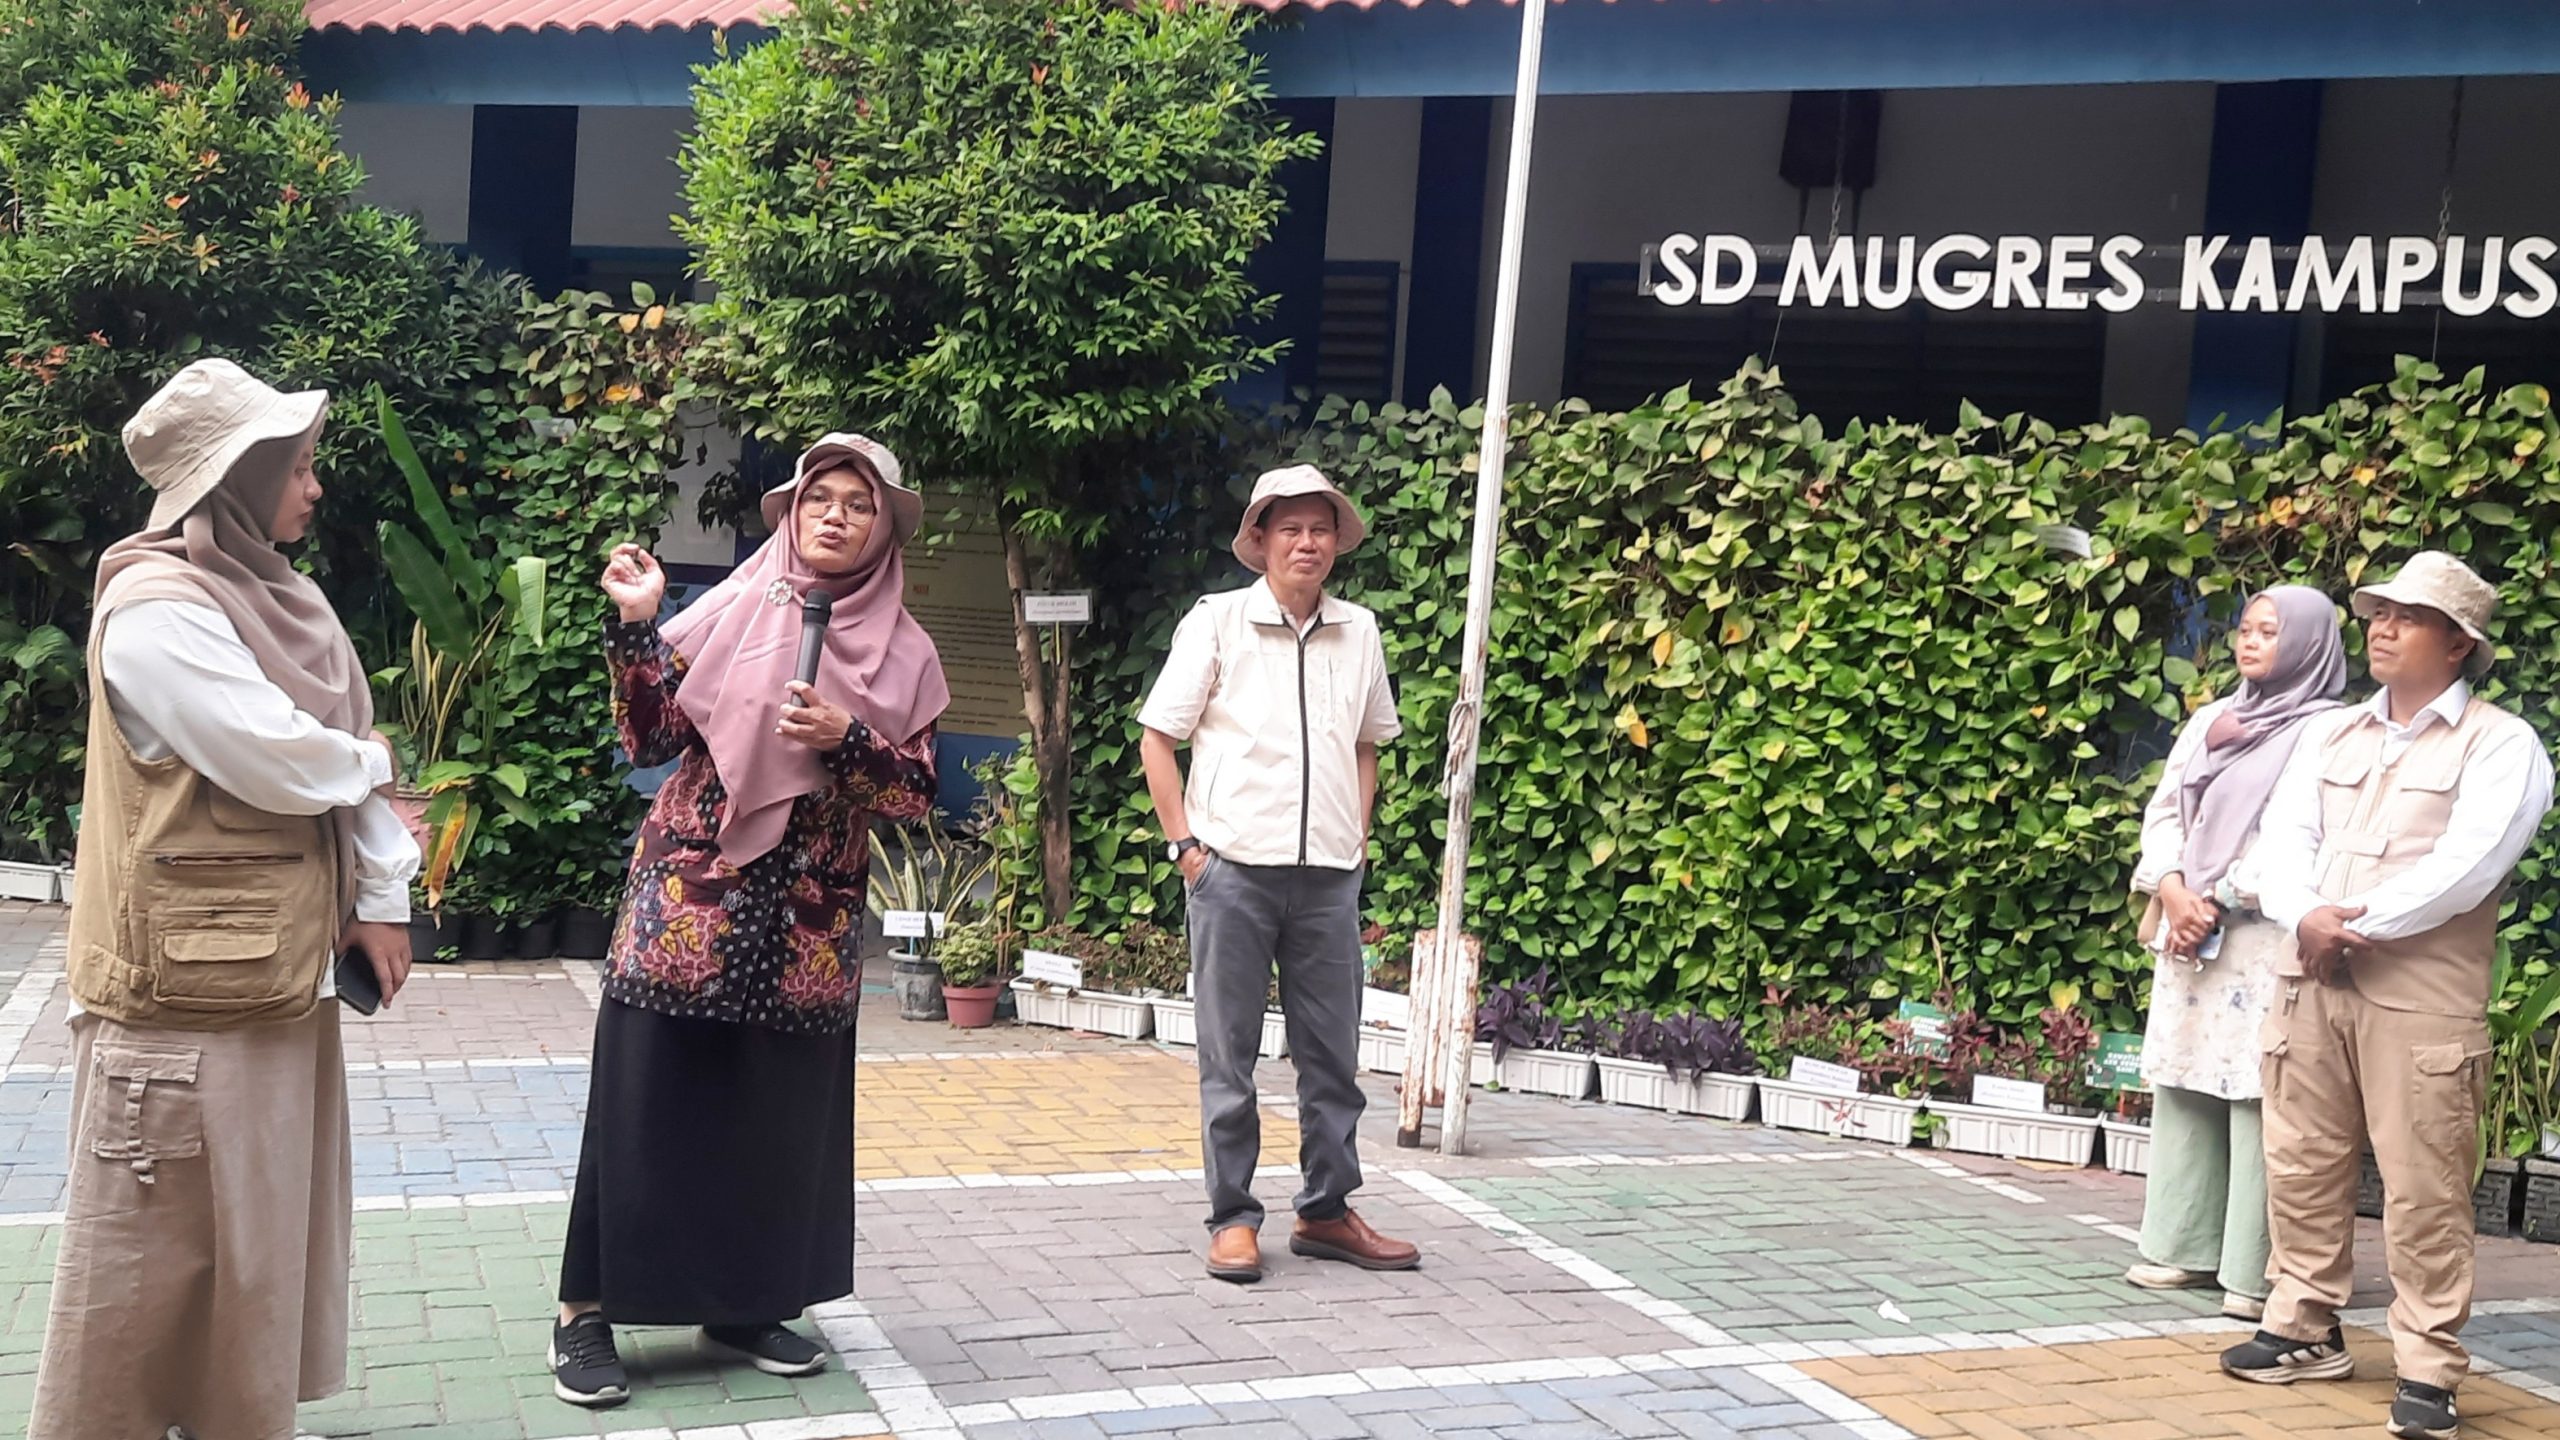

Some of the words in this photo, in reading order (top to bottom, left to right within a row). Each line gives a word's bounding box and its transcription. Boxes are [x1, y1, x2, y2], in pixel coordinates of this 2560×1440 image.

[1653, 234, 1757, 305] SD
[1778, 234, 2144, 312] MUGRES
[2180, 235, 2559, 318] KAMPUS
